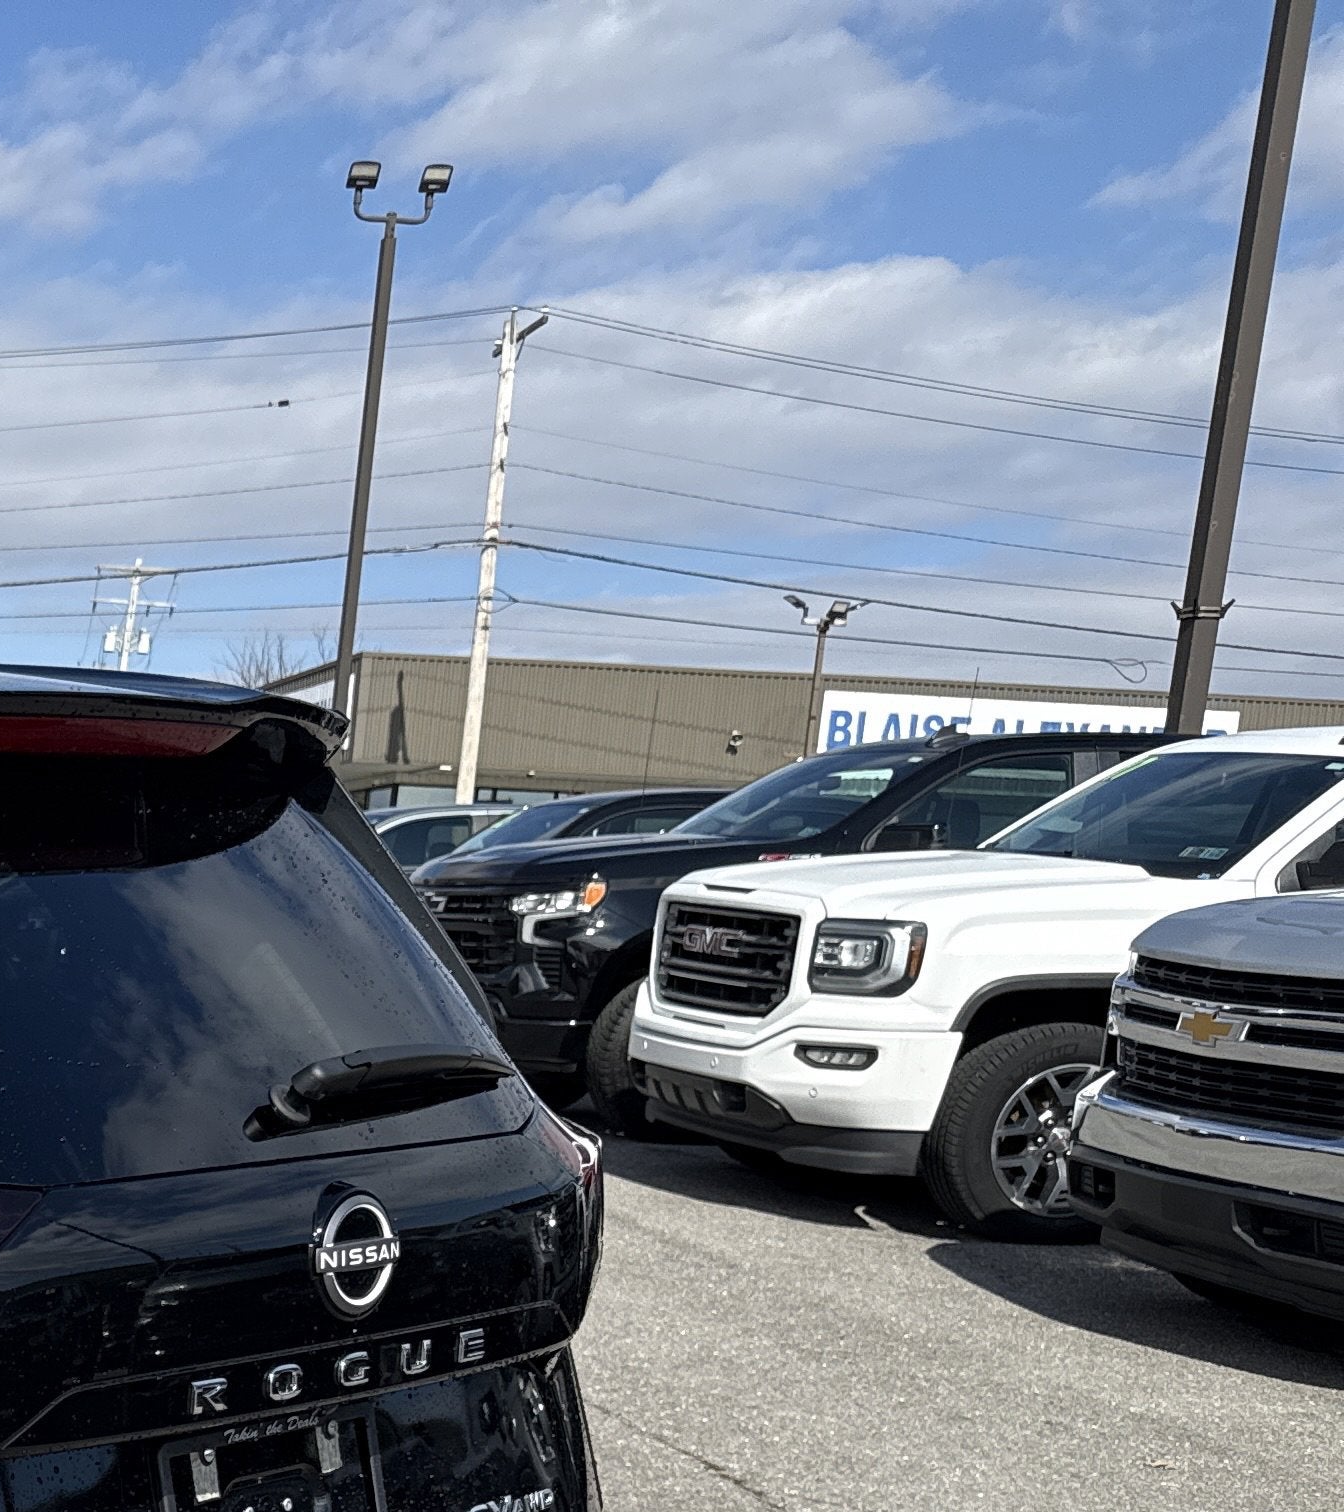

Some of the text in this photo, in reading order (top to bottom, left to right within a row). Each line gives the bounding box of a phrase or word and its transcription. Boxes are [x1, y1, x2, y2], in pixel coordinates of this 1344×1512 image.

[683, 924, 742, 958] GMC
[320, 1241, 400, 1270] NISSAN
[191, 1328, 486, 1415] ROGUE
[265, 1420, 283, 1436] the
[287, 1408, 320, 1431] Deals
